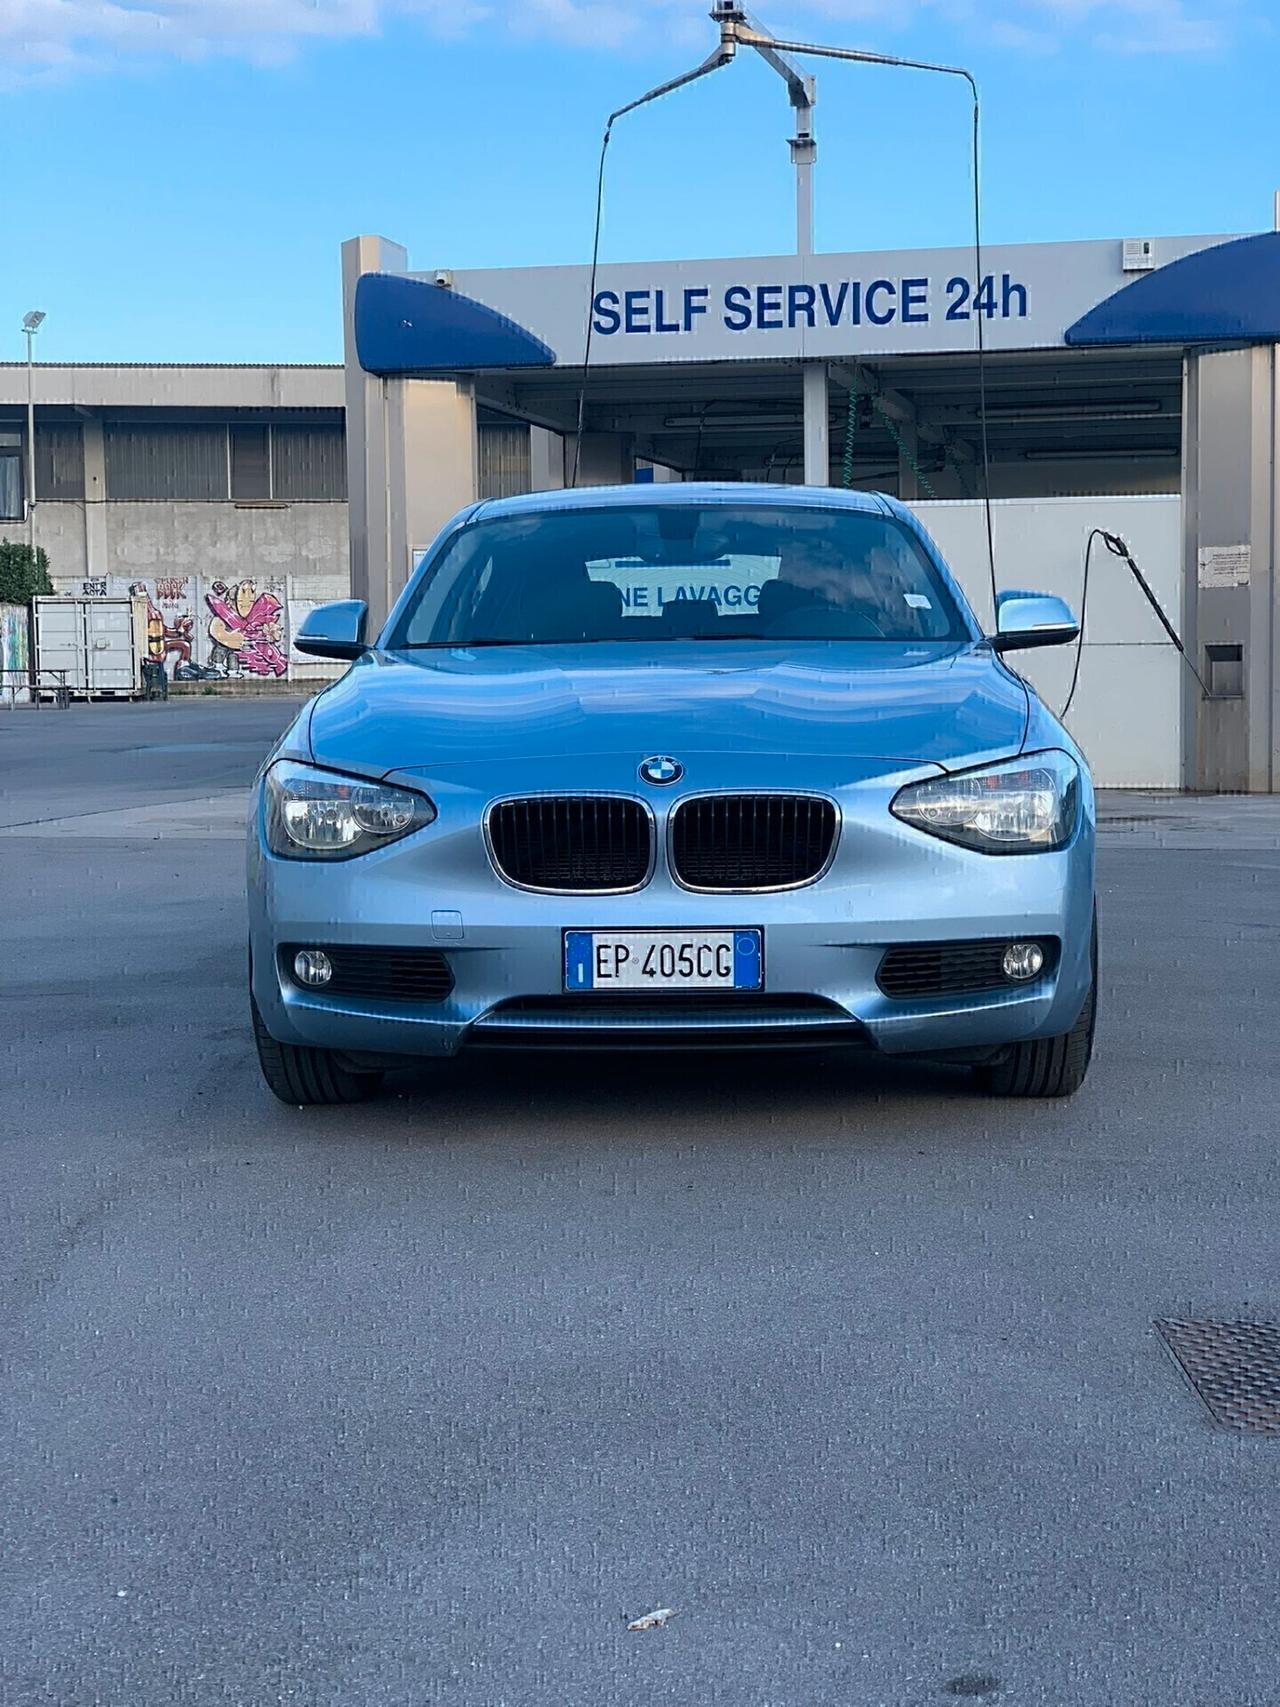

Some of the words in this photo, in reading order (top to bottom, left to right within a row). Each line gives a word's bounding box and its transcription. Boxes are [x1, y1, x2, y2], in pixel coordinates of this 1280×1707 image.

[592, 287, 709, 335] SELF
[723, 277, 929, 331] SERVICE
[945, 273, 1028, 321] 24h
[596, 944, 630, 978] EP
[642, 943, 731, 979] 405CG
